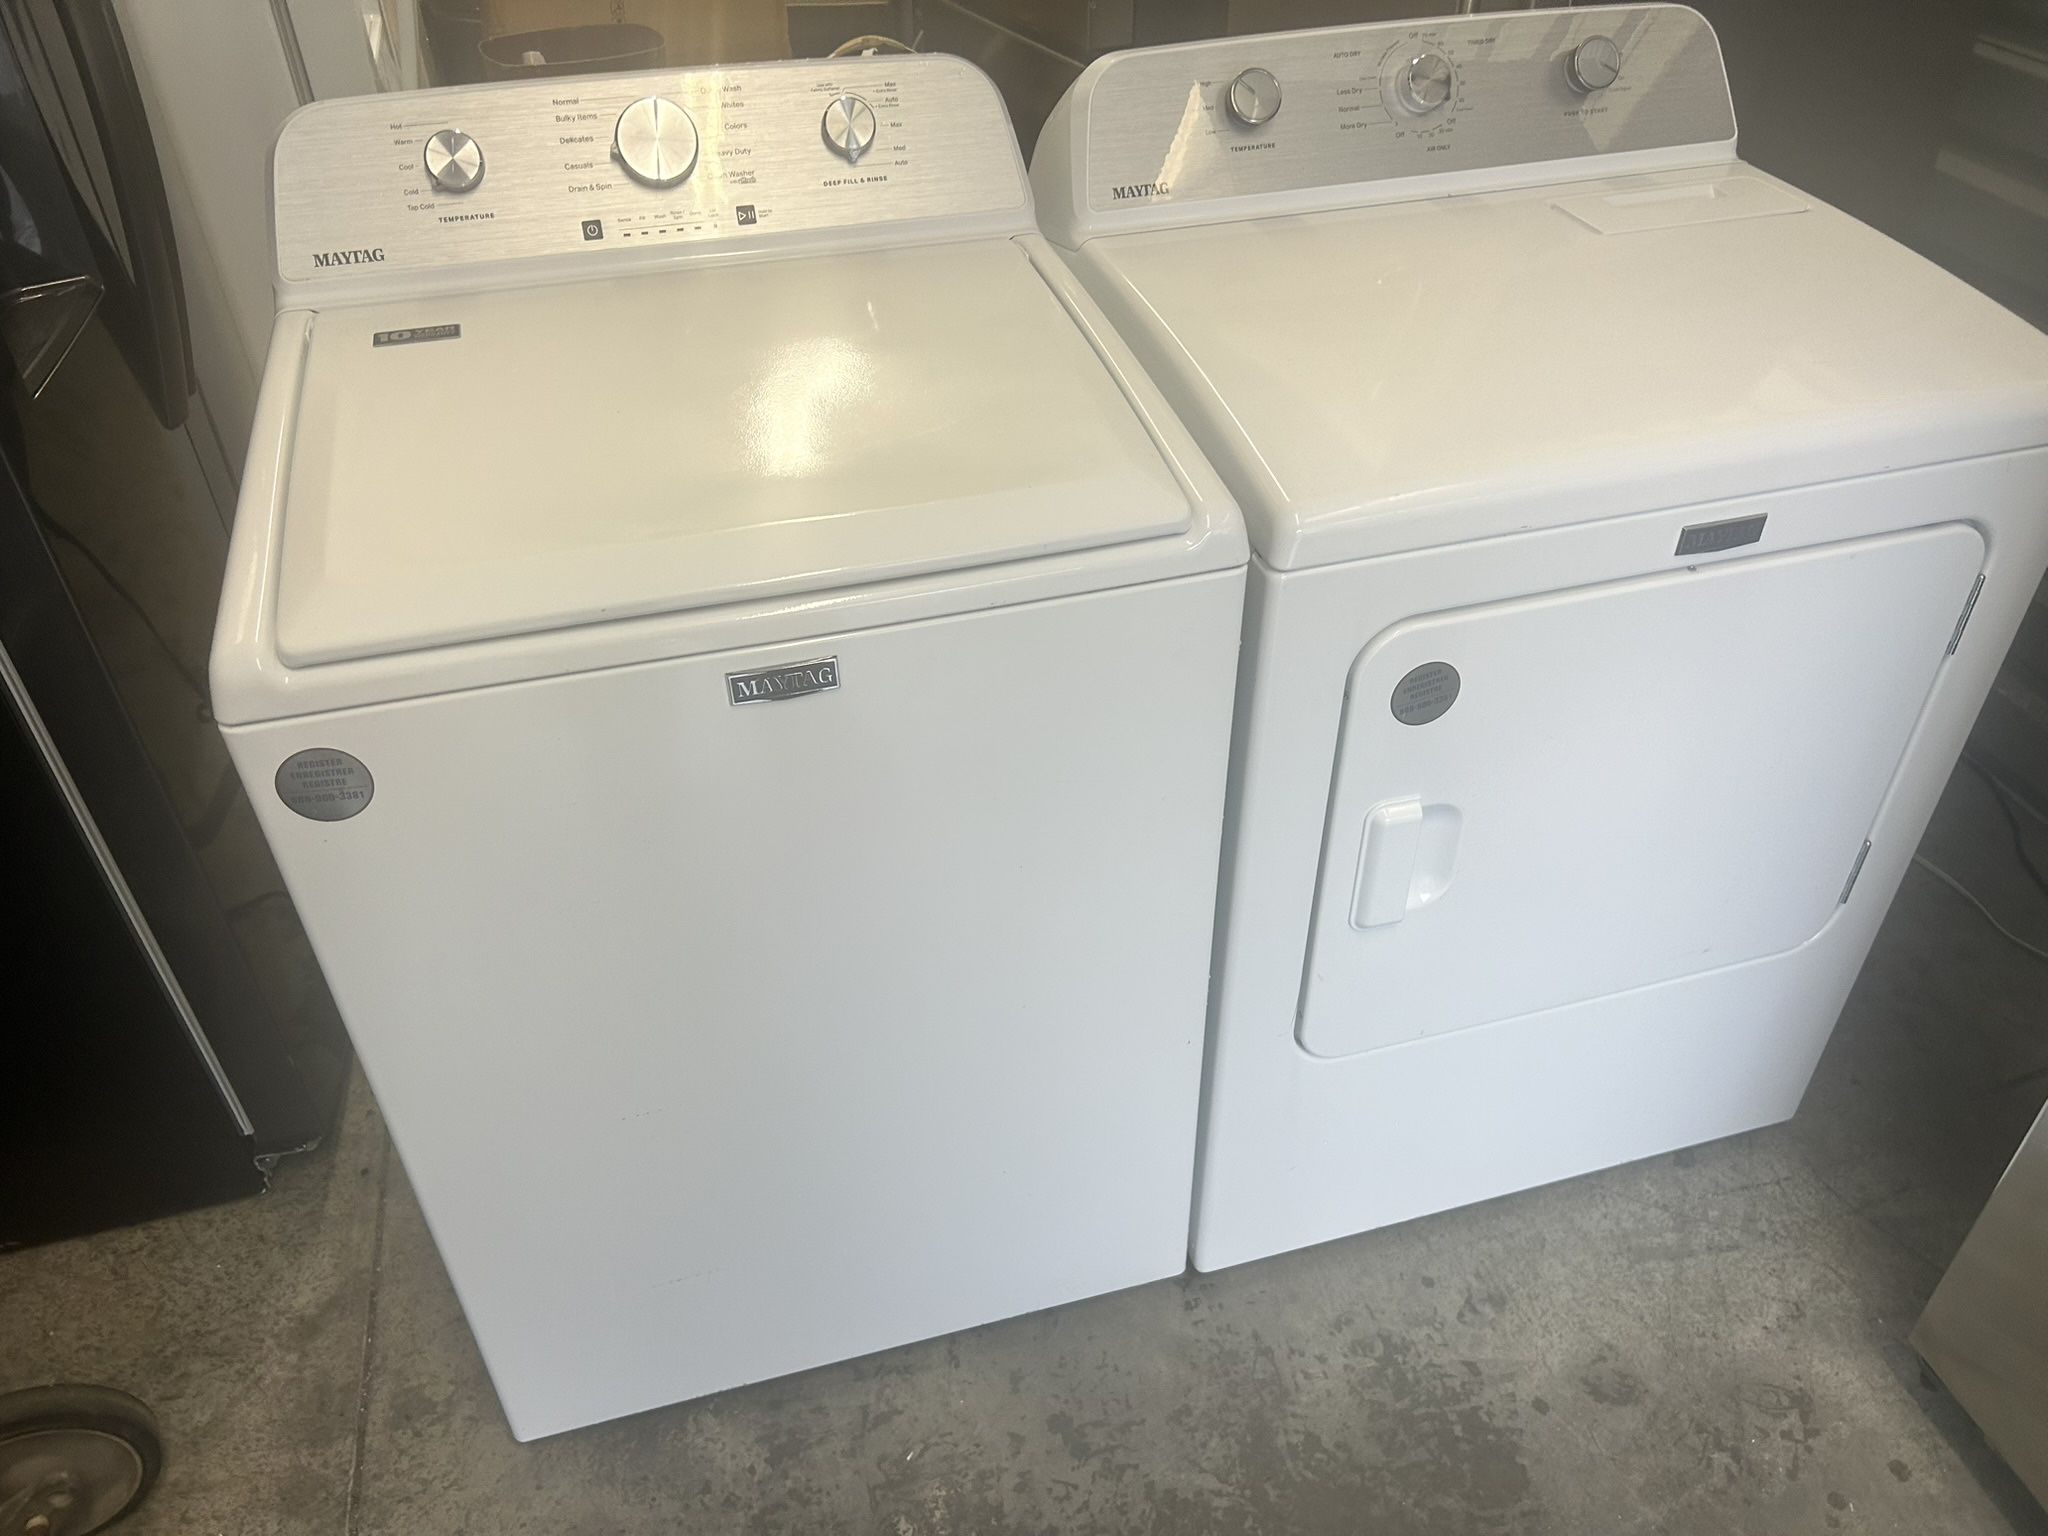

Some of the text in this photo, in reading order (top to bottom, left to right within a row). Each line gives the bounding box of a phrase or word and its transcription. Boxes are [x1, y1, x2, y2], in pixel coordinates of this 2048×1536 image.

[1408, 32, 1419, 40] Off
[1351, 88, 1363, 96] Dry
[552, 97, 580, 106] Normal
[555, 113, 598, 123] Bulky Items
[1446, 117, 1457, 125] Off
[389, 123, 403, 131] Hot
[724, 122, 748, 130] Colors
[1340, 122, 1368, 131] More Dry
[559, 135, 594, 145] Delicates
[734, 147, 752, 156] Duty
[1230, 142, 1276, 153] TEMPERATURE
[1436, 144, 1451, 152] ONLY
[398, 163, 414, 171] Cool
[564, 161, 594, 171] Casuals
[728, 169, 755, 178] Washer
[823, 179, 842, 187] DEEP
[843, 178, 858, 186] FILL
[866, 175, 888, 183] RINSE
[403, 188, 420, 196] Cold
[568, 183, 613, 193] Drain & Spin
[1112, 182, 1170, 201] MAYTAG
[407, 203, 436, 212] Tap Cold
[438, 212, 496, 224] TEMPERATURE
[312, 248, 386, 268] MAYTAG
[377, 330, 412, 343] 10
[736, 667, 834, 698] MAYTAG
[296, 758, 343, 769] REGISTER
